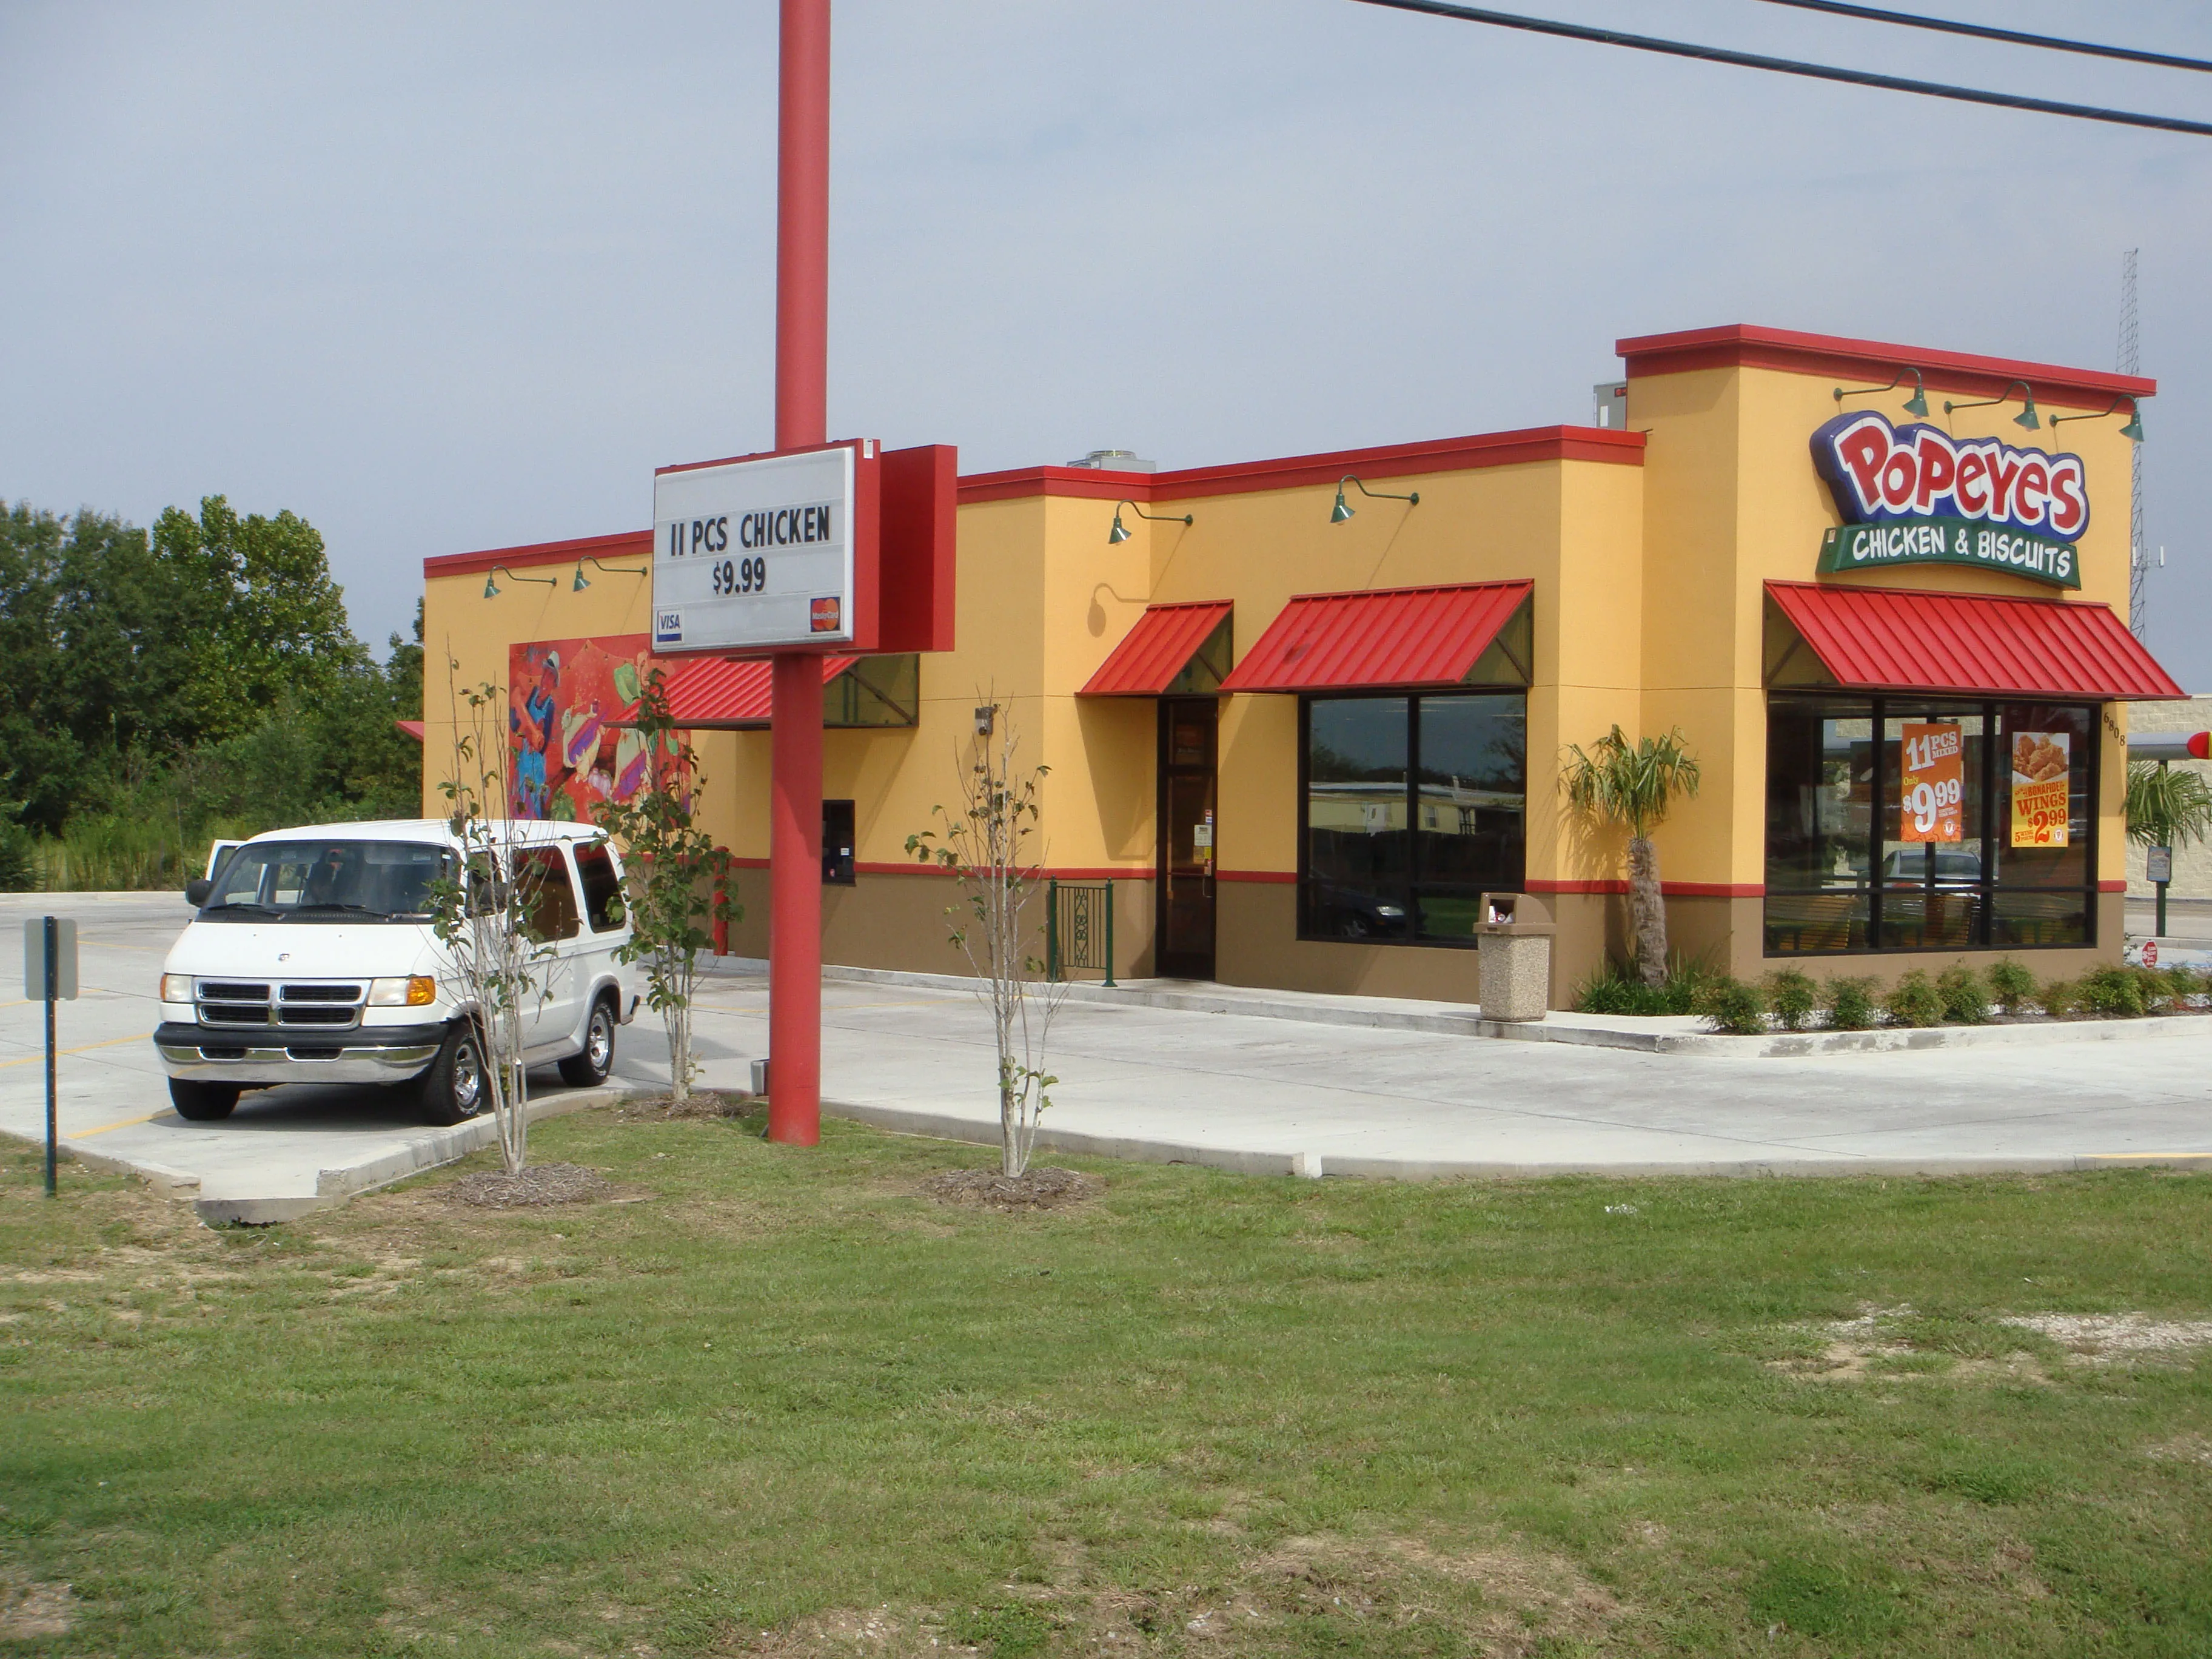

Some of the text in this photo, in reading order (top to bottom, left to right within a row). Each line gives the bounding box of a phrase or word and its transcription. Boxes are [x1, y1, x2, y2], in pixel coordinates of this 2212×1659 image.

[692, 517, 728, 554] PCS
[740, 505, 830, 549] CHICKEN
[1853, 526, 2071, 578] CHICKEN & BISCUITS
[712, 557, 766, 595] $9.99
[660, 614, 680, 629] VISA
[2103, 712, 2125, 746] 6808
[1906, 731, 1957, 772] 11 PCS
[1903, 775, 1919, 786] Only
[2016, 792, 2066, 816] WINGS
